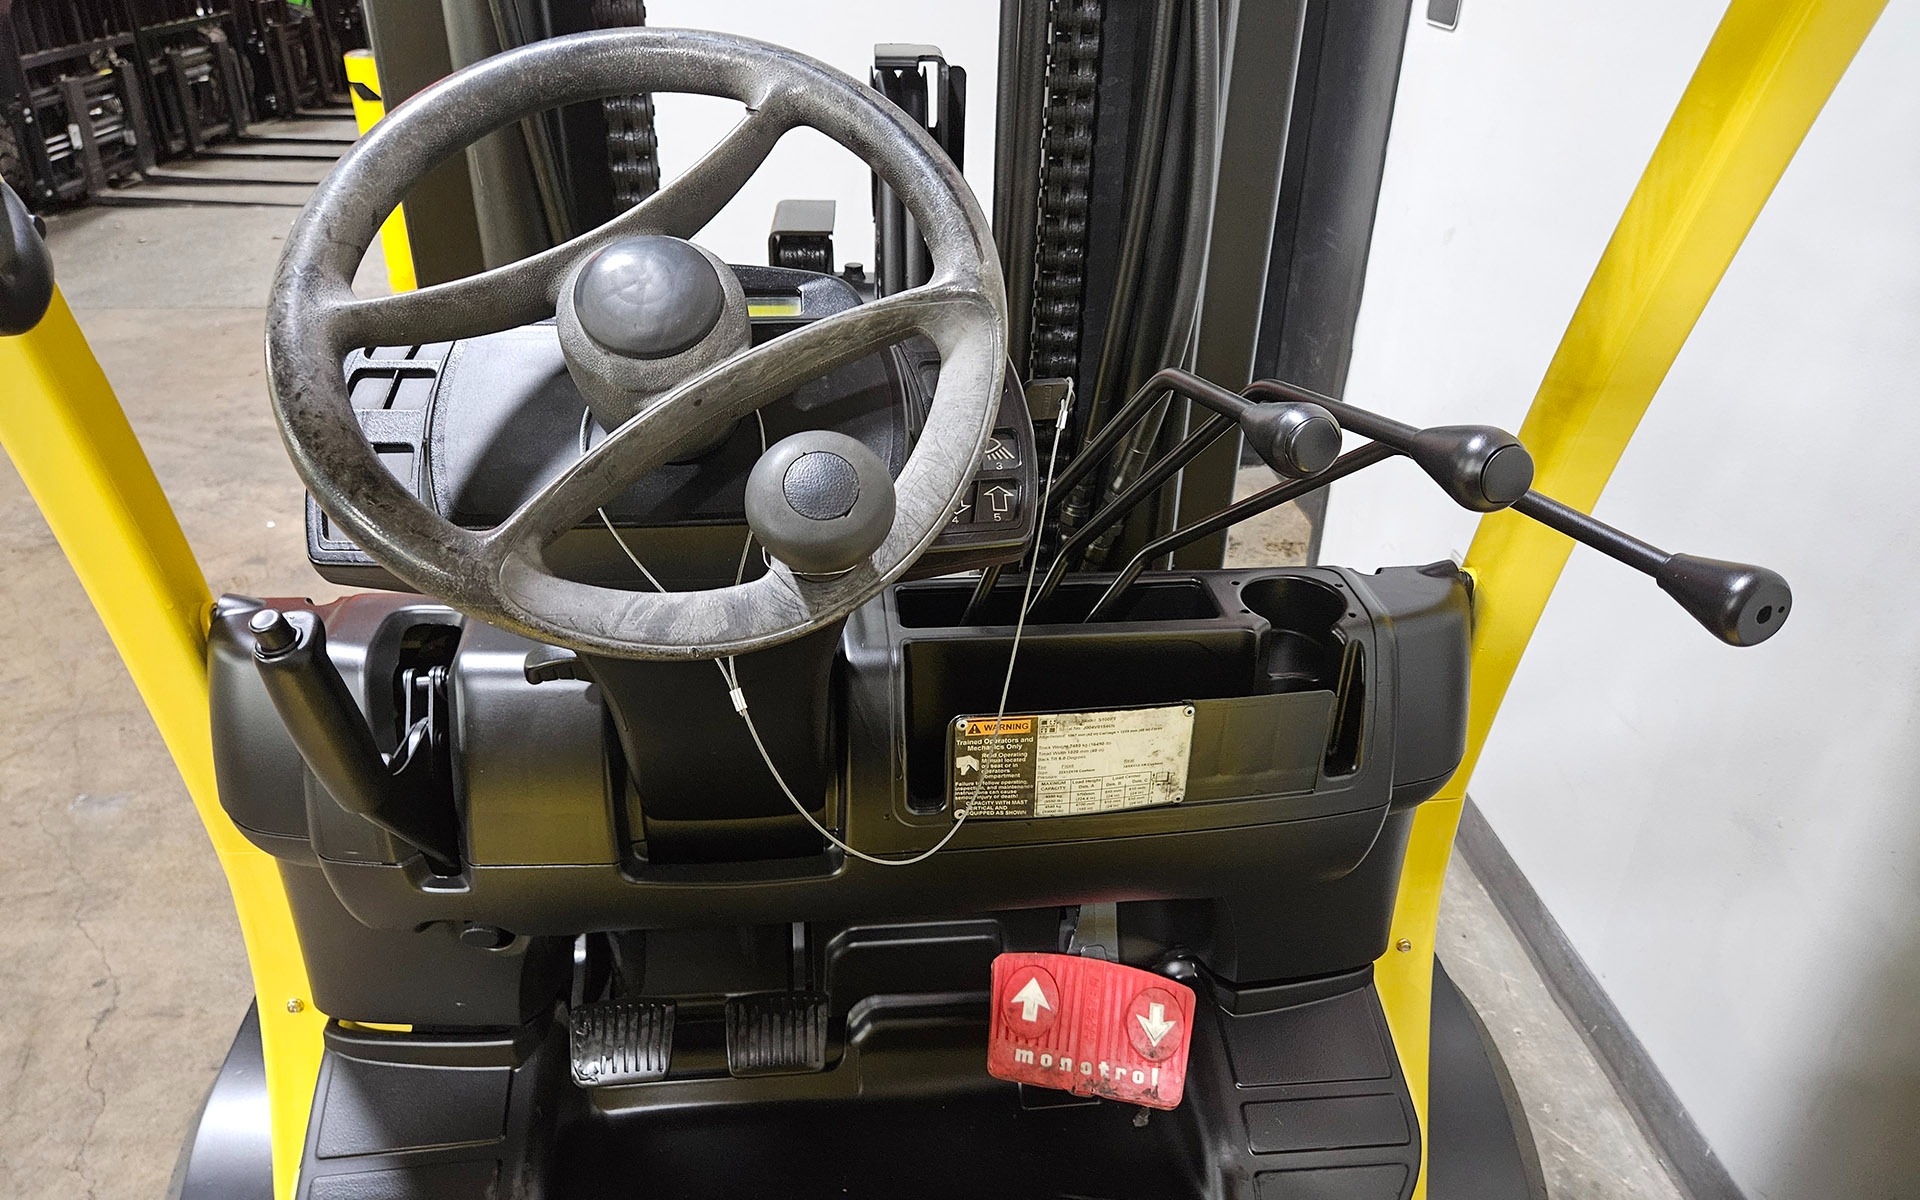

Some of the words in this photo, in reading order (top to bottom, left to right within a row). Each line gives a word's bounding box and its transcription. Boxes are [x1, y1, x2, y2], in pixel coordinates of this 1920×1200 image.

[952, 516, 959, 524] 4
[994, 513, 1002, 522] 5
[984, 722, 1029, 731] WARNING
[1014, 1047, 1160, 1086] monotrol
